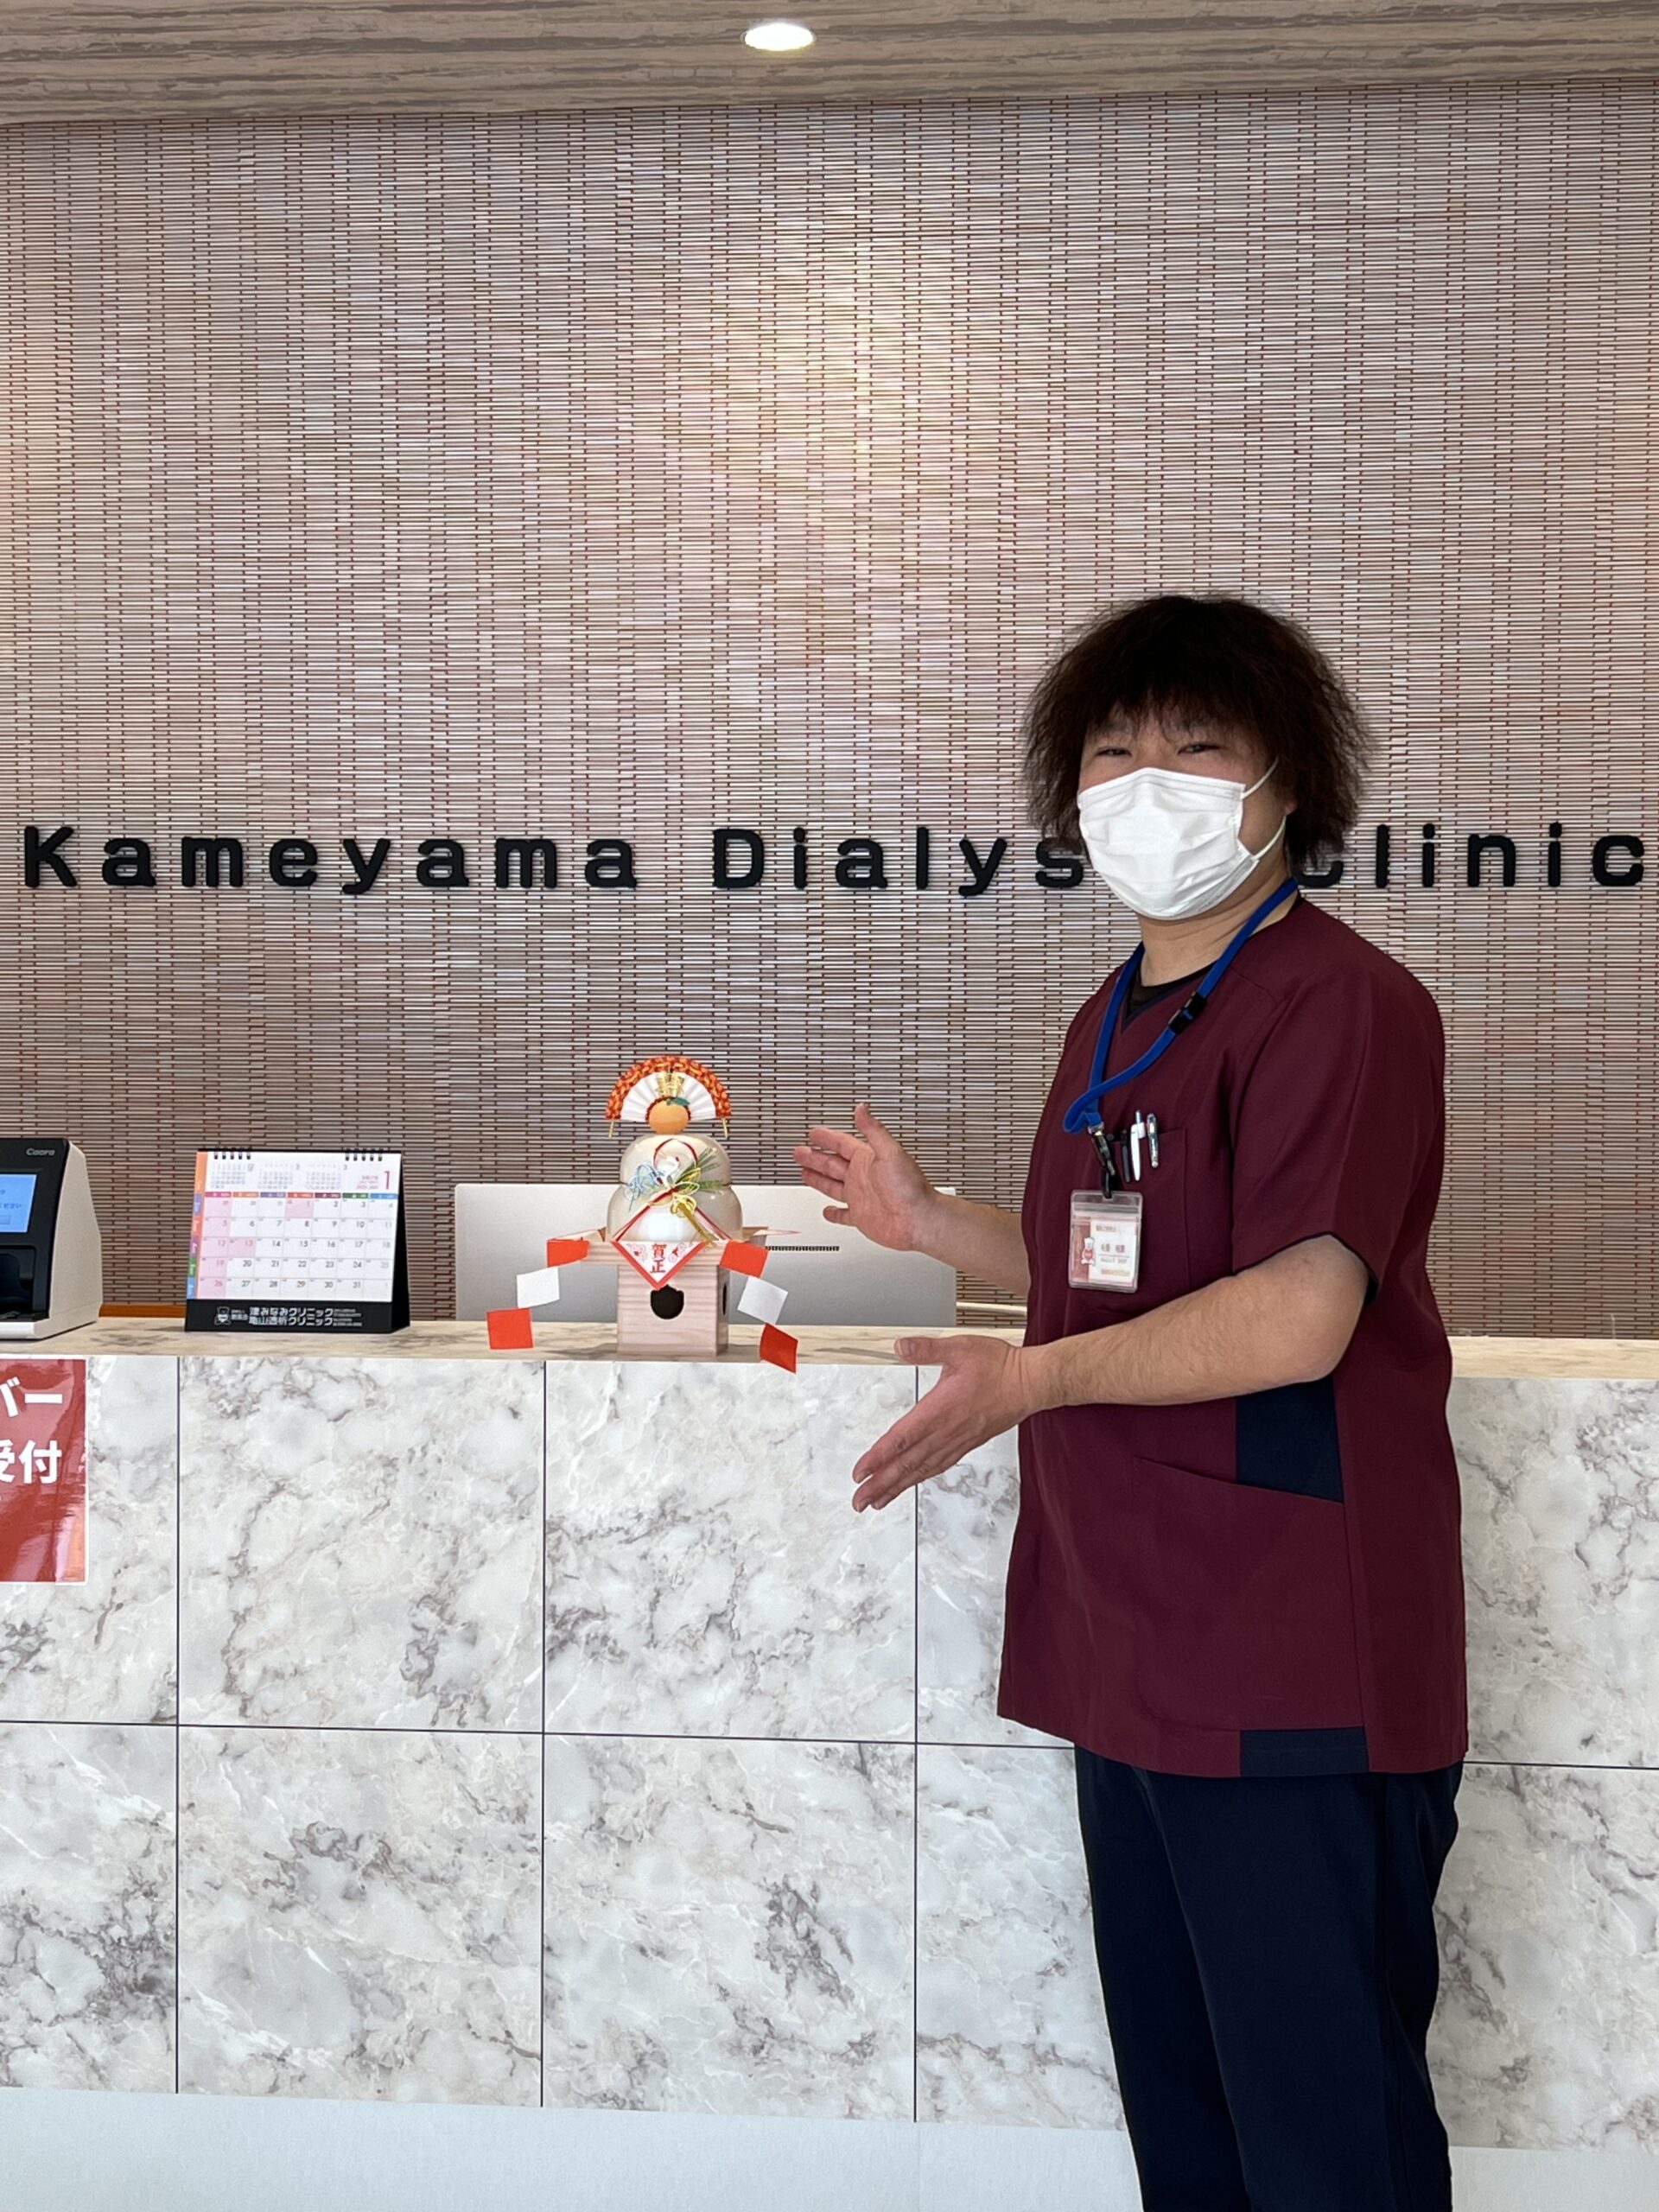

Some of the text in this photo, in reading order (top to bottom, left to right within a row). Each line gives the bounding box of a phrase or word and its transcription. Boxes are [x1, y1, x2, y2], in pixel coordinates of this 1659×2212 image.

[22, 825, 639, 895] Kameyama
[713, 827, 1085, 897] Dialys
[384, 1170, 391, 1191] 1
[650, 1243, 667, 1274] 賀正
